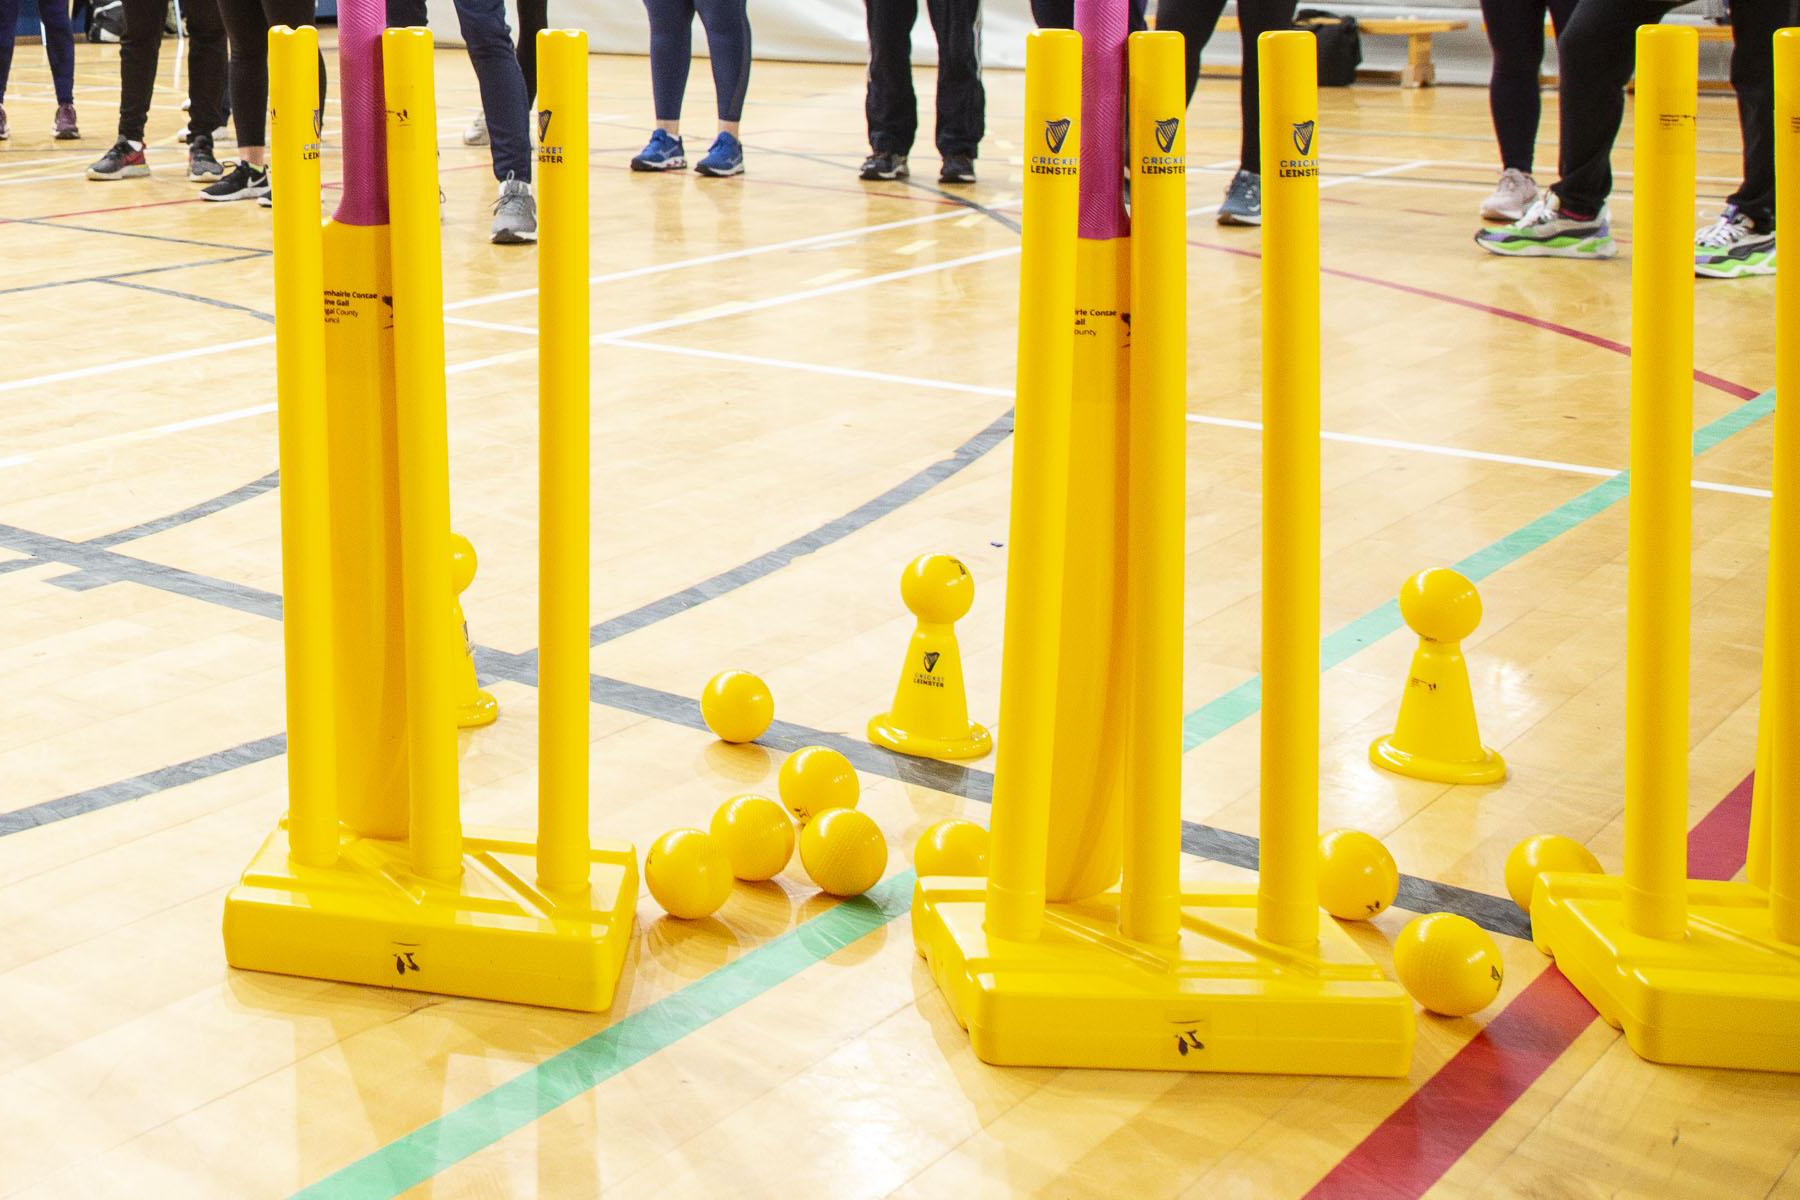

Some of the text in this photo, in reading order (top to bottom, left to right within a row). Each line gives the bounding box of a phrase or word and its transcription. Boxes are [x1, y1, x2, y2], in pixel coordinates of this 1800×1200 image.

[1031, 156, 1077, 165] CRICKET
[1142, 156, 1184, 164] CRICKE
[1280, 160, 1319, 168] CRICK
[1030, 164, 1077, 175] LEINSTER
[324, 290, 351, 298] mhairle
[335, 308, 358, 318] County
[1074, 318, 1086, 326] all
[1074, 329, 1097, 337] ounty
